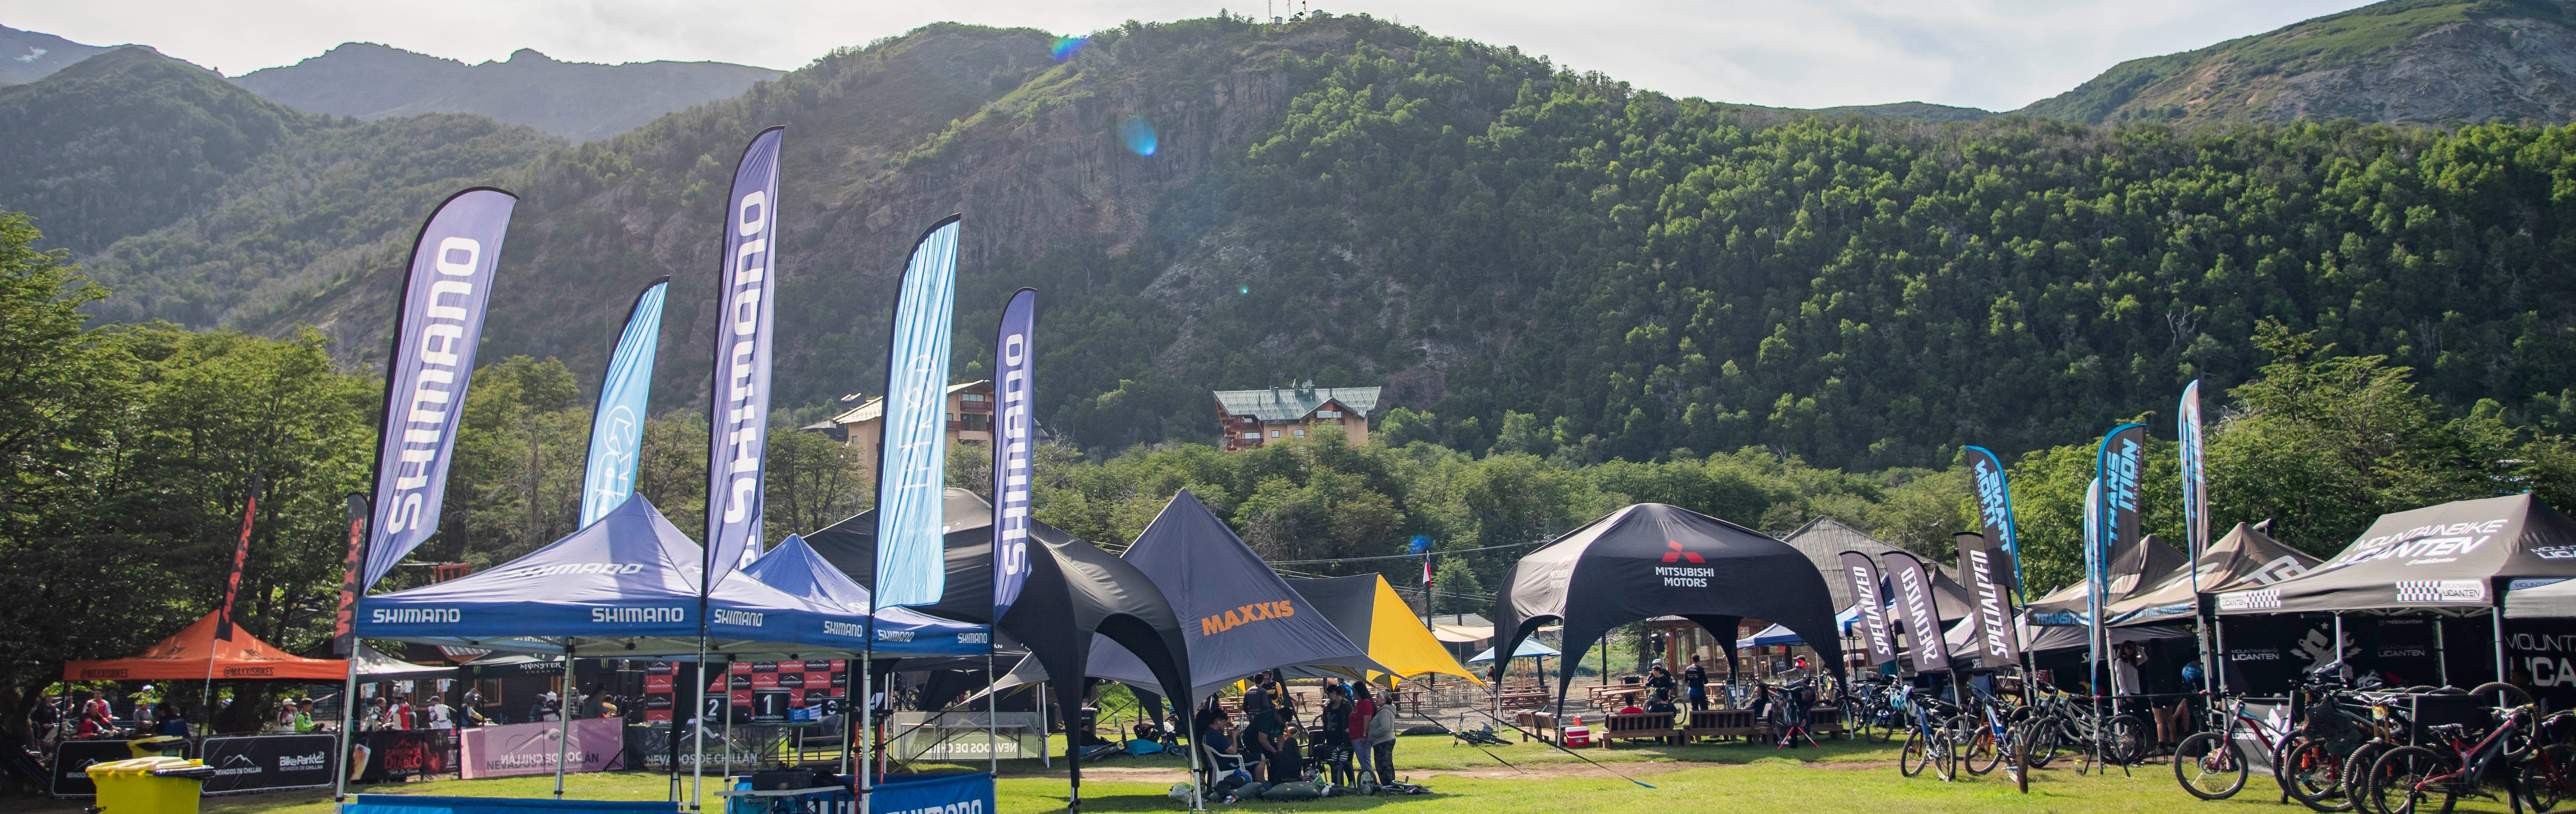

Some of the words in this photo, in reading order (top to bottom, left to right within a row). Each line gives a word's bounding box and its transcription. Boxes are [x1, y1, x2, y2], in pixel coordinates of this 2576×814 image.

[724, 190, 766, 524] SHIMANO
[387, 236, 481, 535] SHIMANO
[1001, 333, 1029, 576] SHIMANO
[2353, 519, 2509, 552] MOUNTAINBIKE
[507, 562, 643, 577] SHIMANO
[1655, 567, 1714, 577] MITSUBISHI
[1664, 577, 1707, 587] MOTORS
[372, 608, 461, 623] SHIMANO
[592, 607, 684, 622] SHIMANO
[714, 608, 763, 627] SHIMANO
[1202, 600, 1295, 636] MAXXIS
[1852, 566, 1891, 656] SPECIALIZED
[823, 621, 863, 637] SHIMANO
[877, 629, 915, 643] SHIMANO
[957, 633, 987, 644] SHIMANO
[223, 666, 274, 677] @MAXXISBIKES
[709, 699, 719, 716] 2
[764, 694, 772, 714] 1
[384, 756, 422, 769] DIABLO
